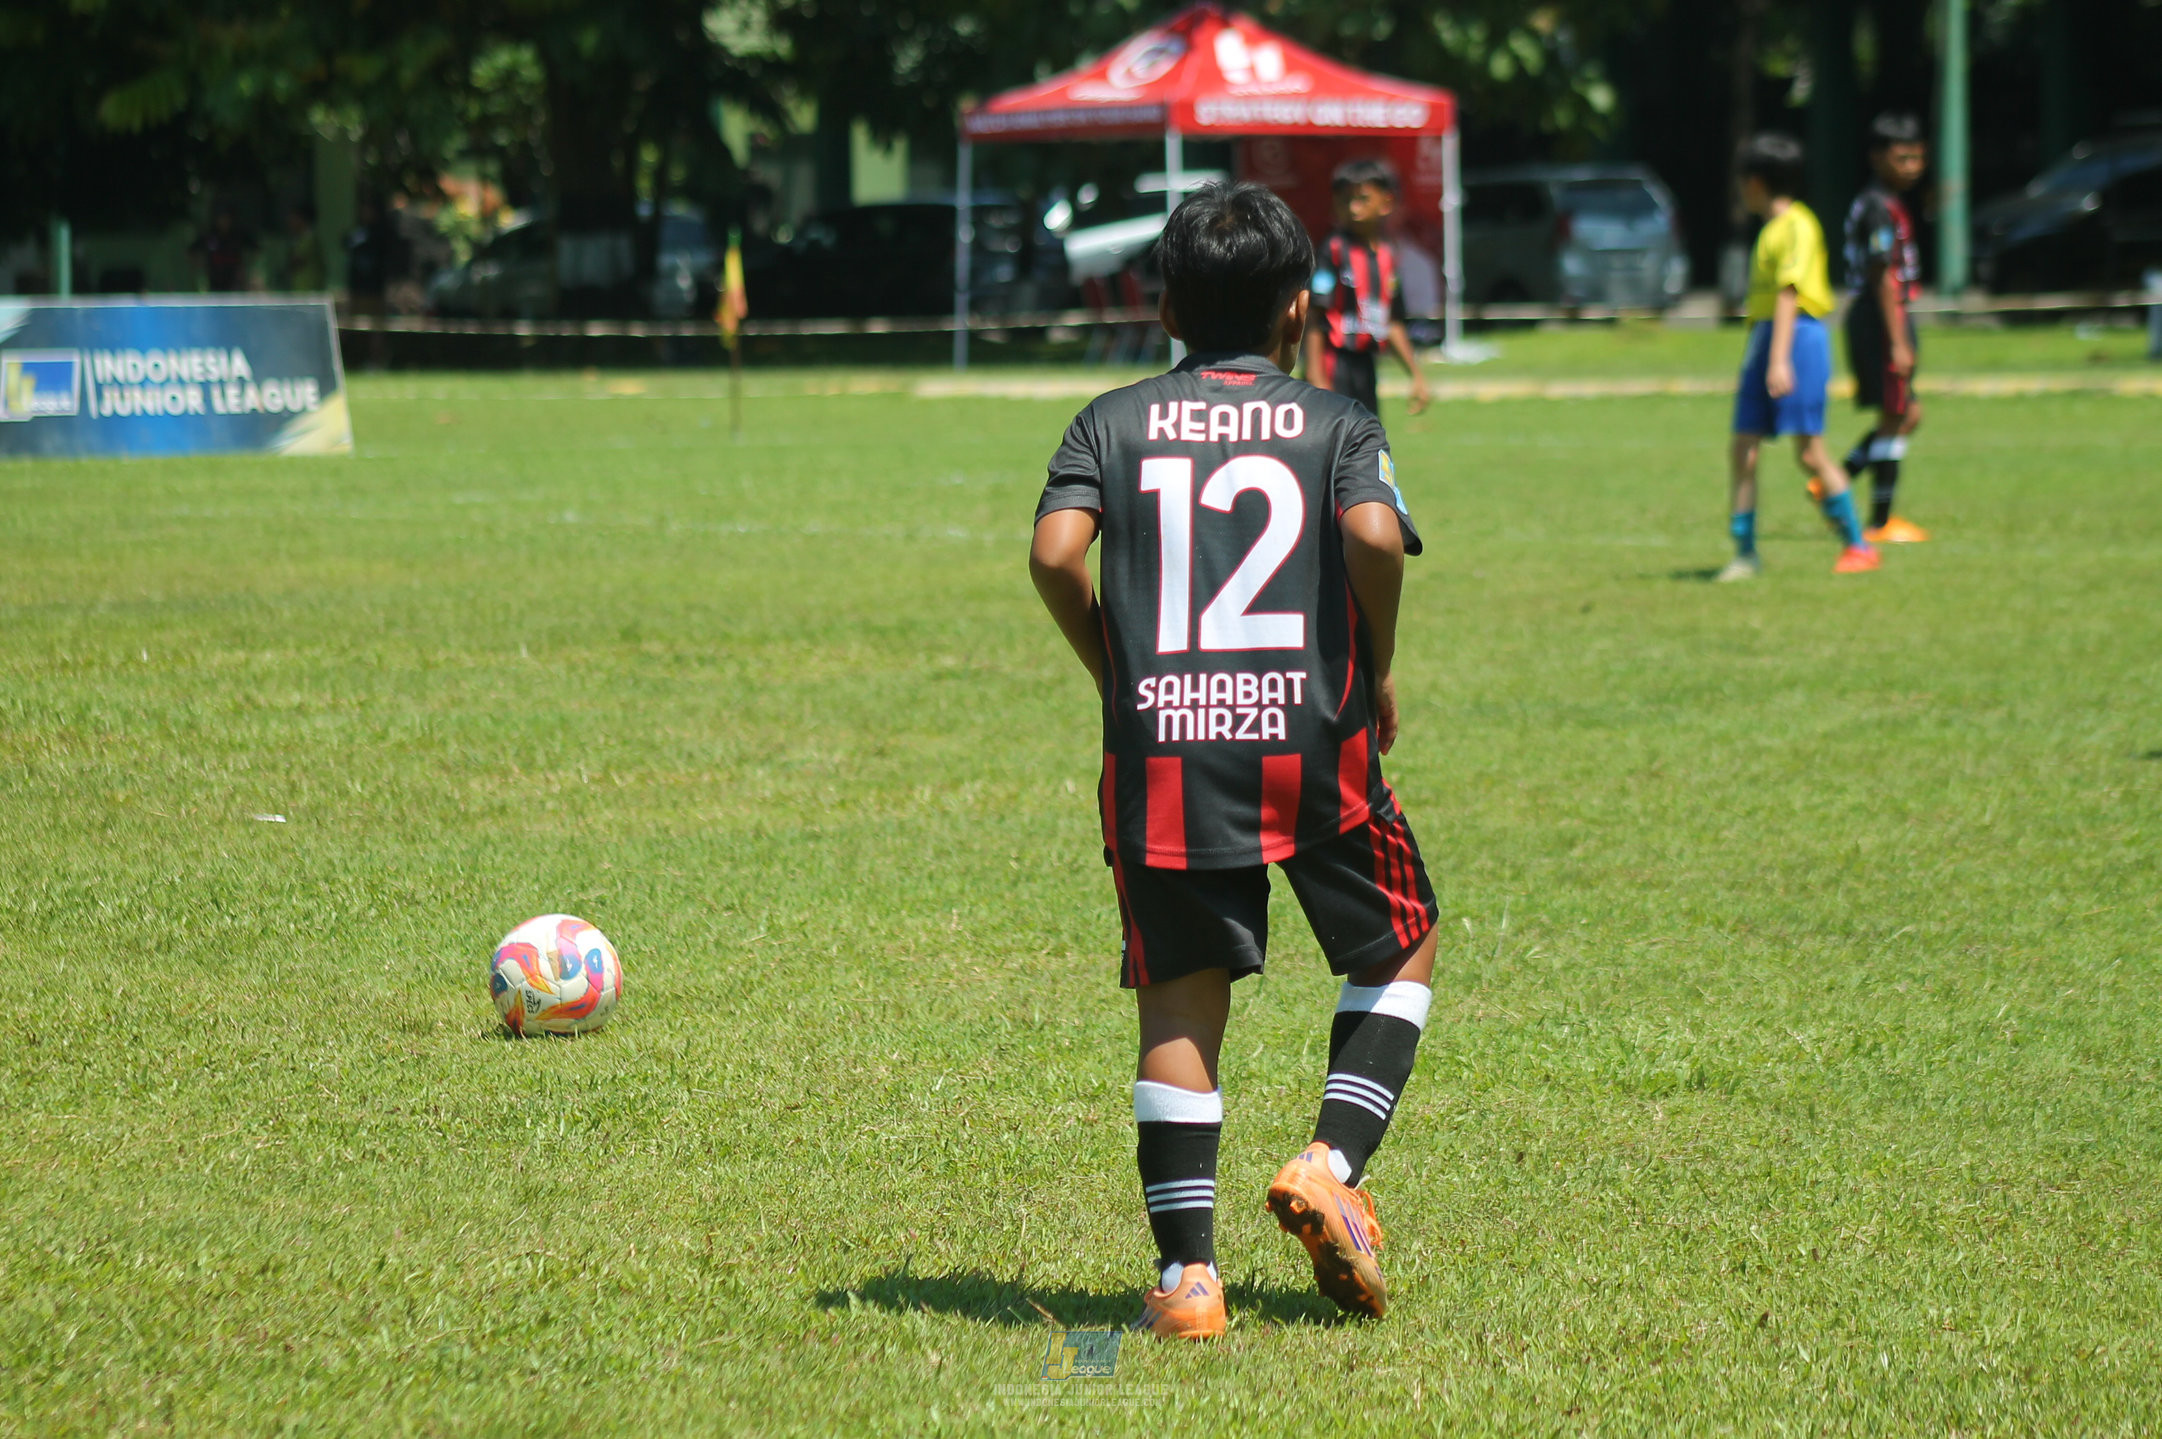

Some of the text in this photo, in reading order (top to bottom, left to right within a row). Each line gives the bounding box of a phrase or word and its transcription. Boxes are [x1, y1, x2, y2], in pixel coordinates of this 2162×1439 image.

[95, 348, 252, 383] INDONESIA
[101, 377, 321, 417] JUNIOR LEAGUE
[1148, 401, 1305, 442] KEANO
[1139, 455, 1305, 655] 12
[1137, 672, 1306, 710] SAHABAT
[1157, 708, 1286, 742] MIRZA
